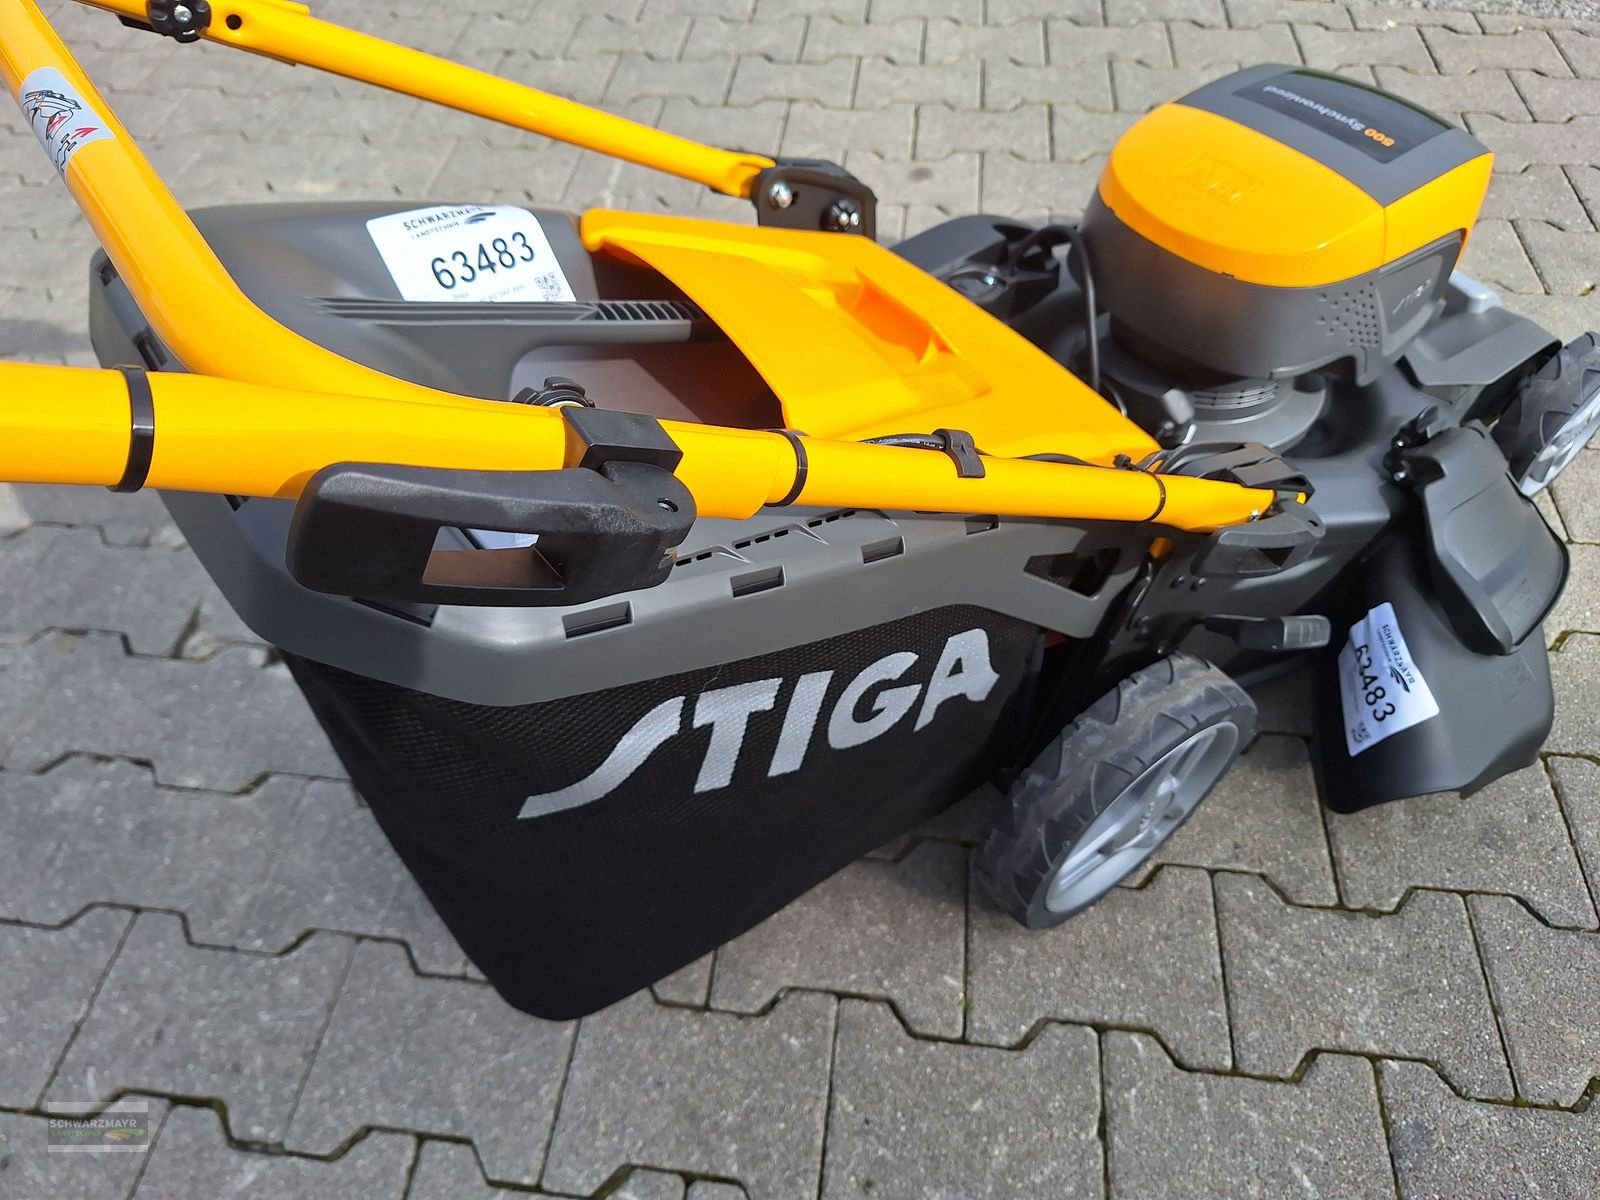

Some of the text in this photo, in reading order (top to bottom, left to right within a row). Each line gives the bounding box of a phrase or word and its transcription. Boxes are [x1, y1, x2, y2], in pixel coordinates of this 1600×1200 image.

[1263, 85, 1365, 131] Synchronized
[431, 231, 535, 289] 63483
[517, 628, 1000, 819] STIGA
